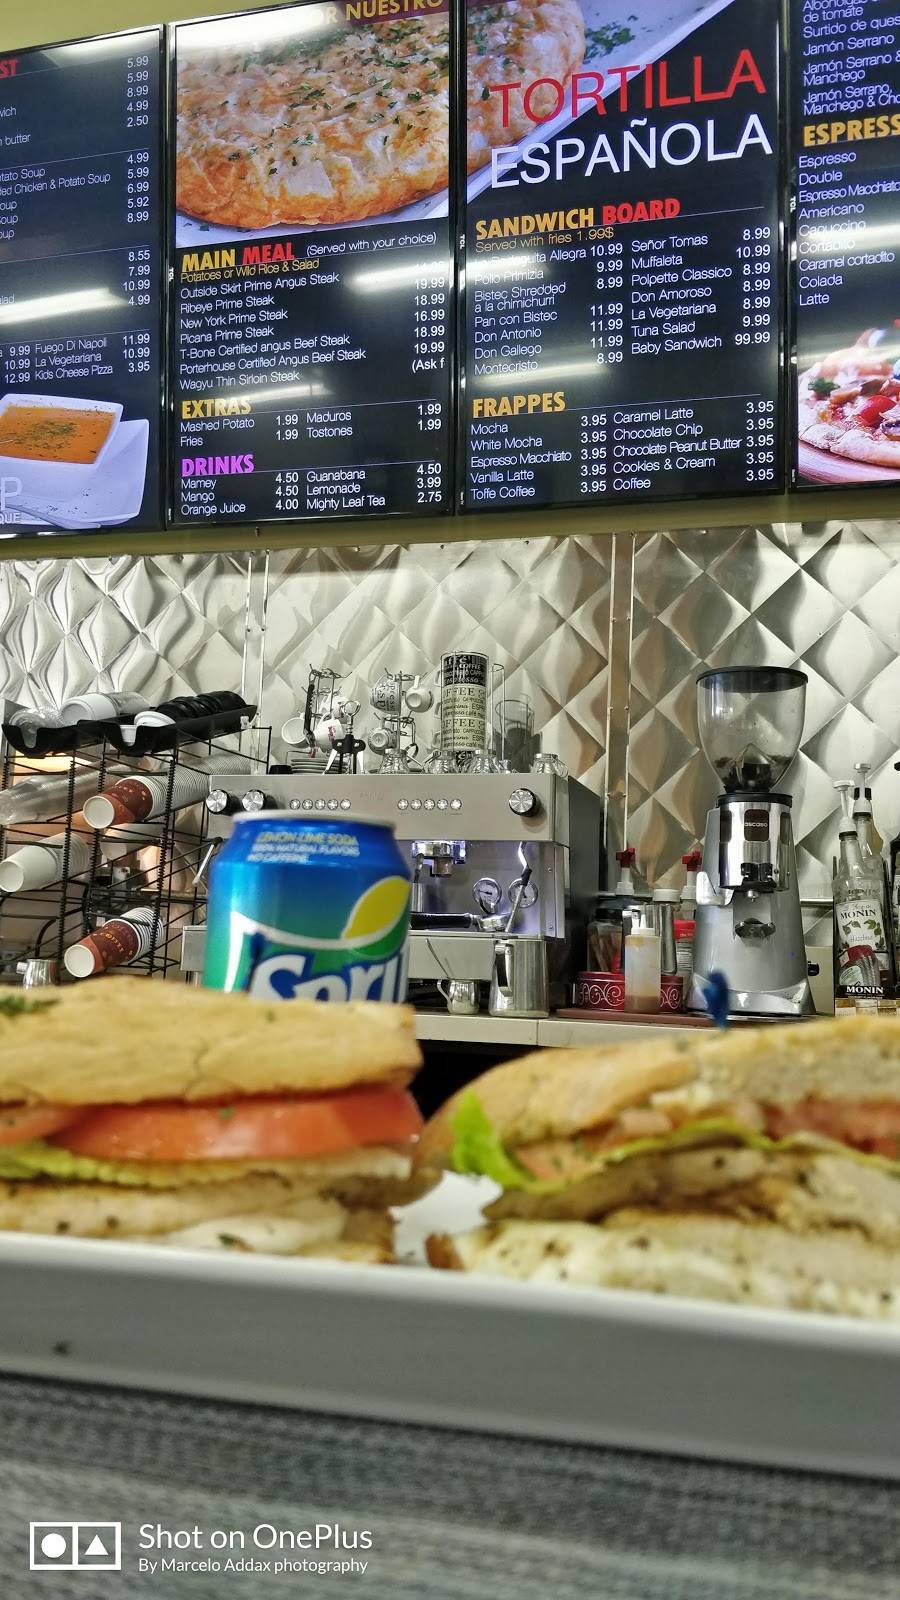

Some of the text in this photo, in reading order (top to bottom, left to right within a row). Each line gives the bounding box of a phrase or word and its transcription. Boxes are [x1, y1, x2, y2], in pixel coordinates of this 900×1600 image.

[803, 6, 863, 24] de tomate
[803, 21, 867, 39] Surtido de
[803, 33, 894, 56] Jamón Serrano
[128, 56, 149, 68] 5.99
[490, 49, 766, 128] TORTILLA
[127, 115, 148, 127] 2.50
[5, 133, 31, 145] butter
[491, 114, 773, 189] ESPAÑOLA
[799, 151, 856, 168] Espresso
[21, 168, 45, 179] Soup
[799, 171, 842, 186] Double
[15, 173, 110, 194] Chicken & Potato Soup
[128, 182, 149, 193] 6.99
[799, 182, 900, 202] Espresso Macchiato
[128, 197, 149, 208] 5.92
[799, 203, 864, 219] Americano
[476, 198, 680, 240] SANDWICH BOARD
[475, 226, 614, 253] Served with fries 1.99$
[632, 228, 770, 252] Señor Tomas 8.99
[129, 250, 150, 261] 8.55
[182, 232, 436, 272] MAIN MEAL (Served with your choice)
[549, 248, 586, 262] Allegra
[590, 244, 623, 257] 10.99
[181, 258, 319, 283] Potatoes or Wild Rice & Salad
[632, 254, 683, 269] Muffaleta
[799, 256, 844, 271] Caramel
[123, 280, 150, 291] 10.99
[180, 272, 339, 299] Outside Skirt Prime Angus Steak
[632, 267, 732, 287] Polpette Classico
[799, 276, 842, 289] Colada
[180, 293, 444, 315] Ribeye Prime Steak 18.99
[799, 294, 829, 306] Latte
[180, 309, 444, 329] New York Prime Steak 16.99
[474, 320, 623, 343] Don Antonio 11.99
[35, 334, 150, 355] Fuego Di Napoli 11.99
[632, 332, 770, 355] Baby Sandwich 99.99
[35, 353, 101, 367] La Vegetariana
[180, 348, 437, 374] Porterhouse Certified Angus Beef Steak (Ask
[474, 361, 538, 375] Montecristo
[5, 373, 30, 384] 12.99
[35, 362, 150, 381] Kids Cheese Pizza 3.95
[180, 370, 300, 391] Wagyu Thin Sirloin Steak
[182, 399, 251, 419] EXTRAS
[307, 404, 441, 423] Maduros 1.99
[473, 392, 566, 418] FRAPPES
[613, 401, 774, 424] Caramel Latte 3.95
[180, 415, 299, 432] Mashed Potato 1.99
[307, 426, 352, 438] Tostones
[471, 414, 606, 435] Mocha 3.95
[180, 436, 203, 446] Fries
[613, 438, 742, 458] Chocolate Peanut Butter
[181, 454, 255, 476] DRINKS
[471, 451, 572, 469] Espresso Macchiato
[613, 456, 715, 474] Cookies & Cream
[276, 472, 299, 483] 4.50
[307, 470, 365, 482] Guanabana
[307, 477, 441, 495] Lemonade 3.99
[471, 486, 535, 500] Toffe Coffee
[181, 491, 214, 503] Mango
[307, 491, 442, 511] Mighty Leaf Tea 2.75
[181, 499, 299, 516] Orange Juice 4.00
[840, 909, 876, 918] MONIN
[846, 985, 884, 994] MONIN
